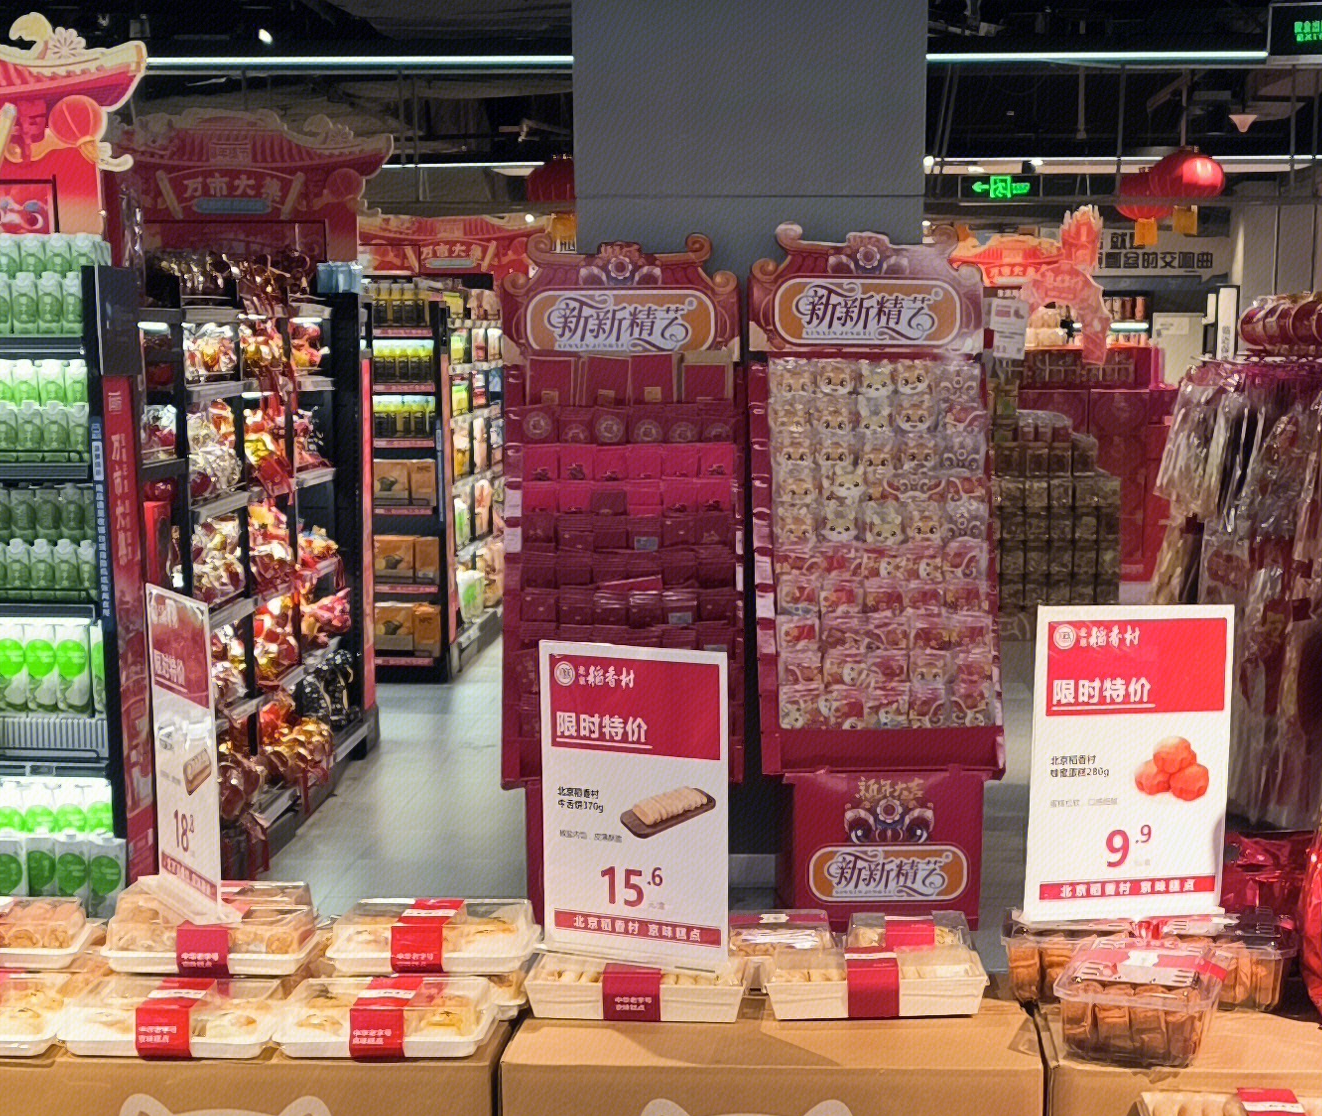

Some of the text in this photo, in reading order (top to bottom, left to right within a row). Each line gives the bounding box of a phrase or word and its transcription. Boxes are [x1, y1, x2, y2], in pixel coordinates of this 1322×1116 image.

[546, 294, 692, 345] 新新精艺
[794, 285, 937, 340] 新新精艺
[1089, 624, 1141, 649] 稻香村
[588, 664, 635, 690] 稻香村
[1052, 676, 1152, 706] 限时特价
[555, 711, 648, 744] 限时特价
[1050, 754, 1096, 766] 北京稻香村
[1105, 824, 1152, 868] 9.9
[600, 865, 664, 908] 15.6
[827, 850, 946, 897] 新新精艺
[1060, 878, 1196, 899] 北京稻香村 京味糕点
[573, 914, 701, 943] 北京稻香村 京味糕点
